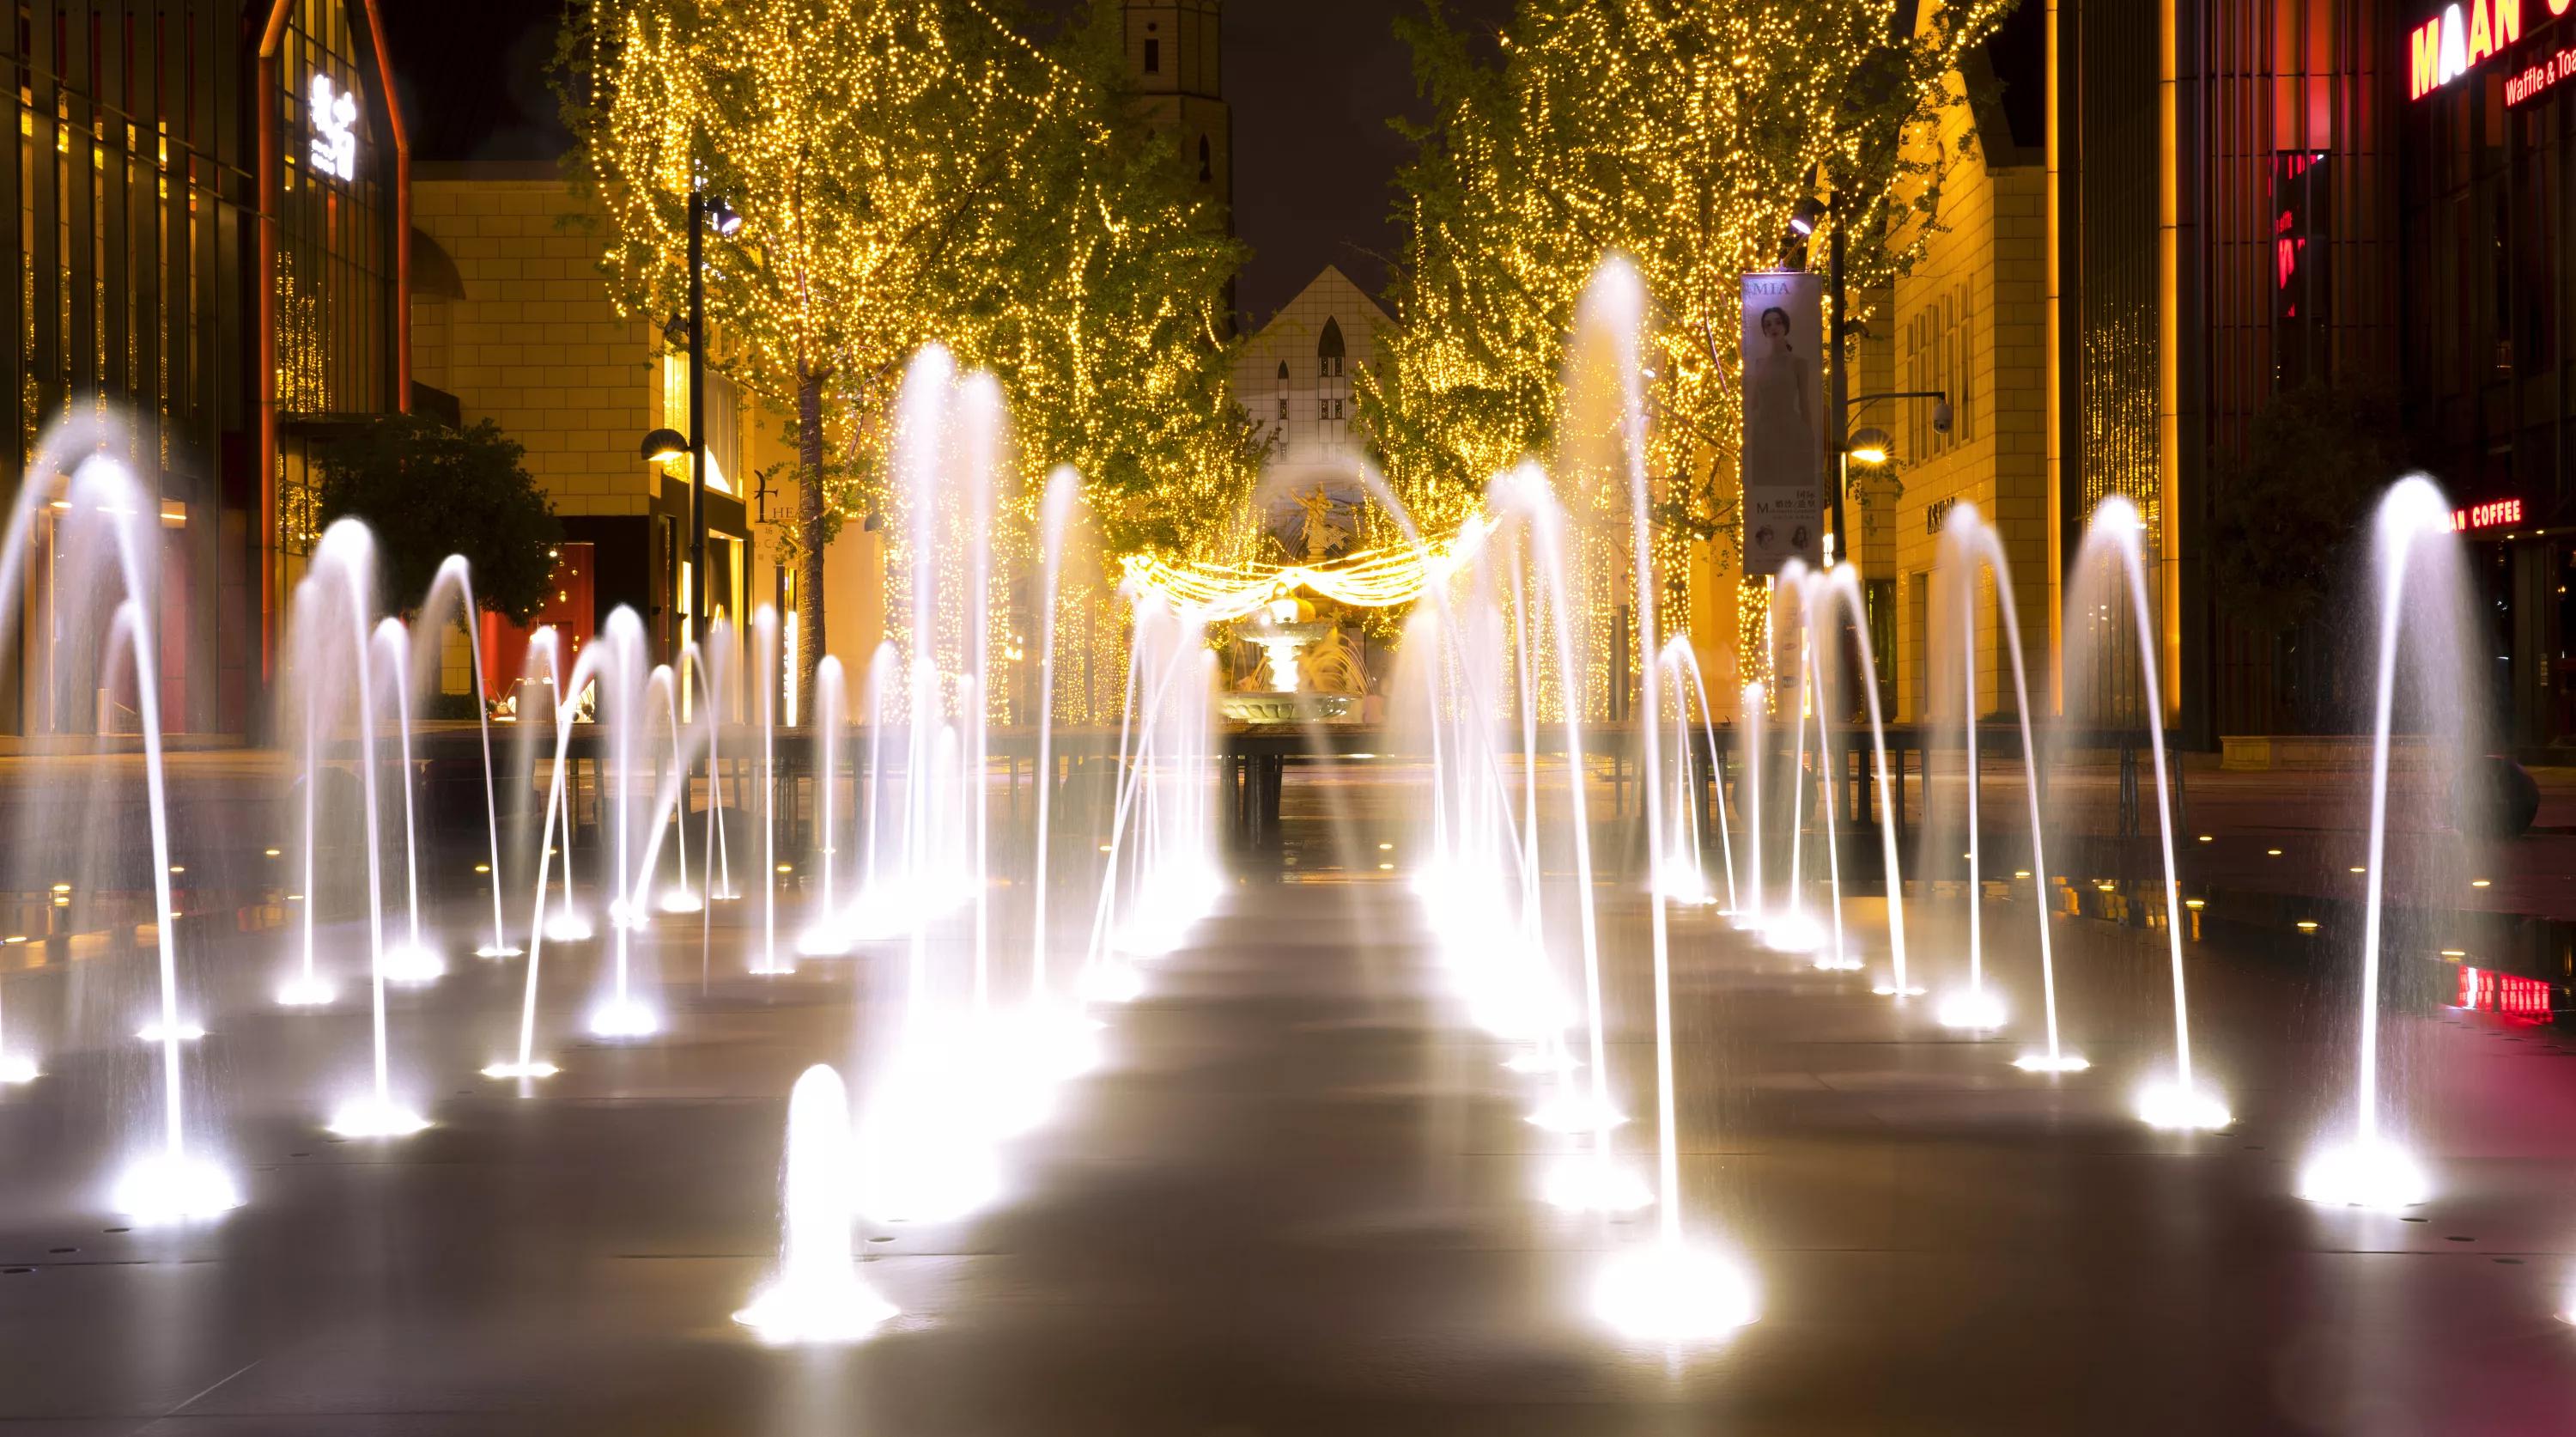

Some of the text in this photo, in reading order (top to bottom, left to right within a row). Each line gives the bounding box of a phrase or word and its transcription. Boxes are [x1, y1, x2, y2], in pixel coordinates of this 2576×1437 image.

[2411, 0, 2520, 101] MAAN
[2506, 66, 2544, 107] Waffle
[2547, 61, 2555, 85] &
[2472, 499, 2521, 527] COFFEE
